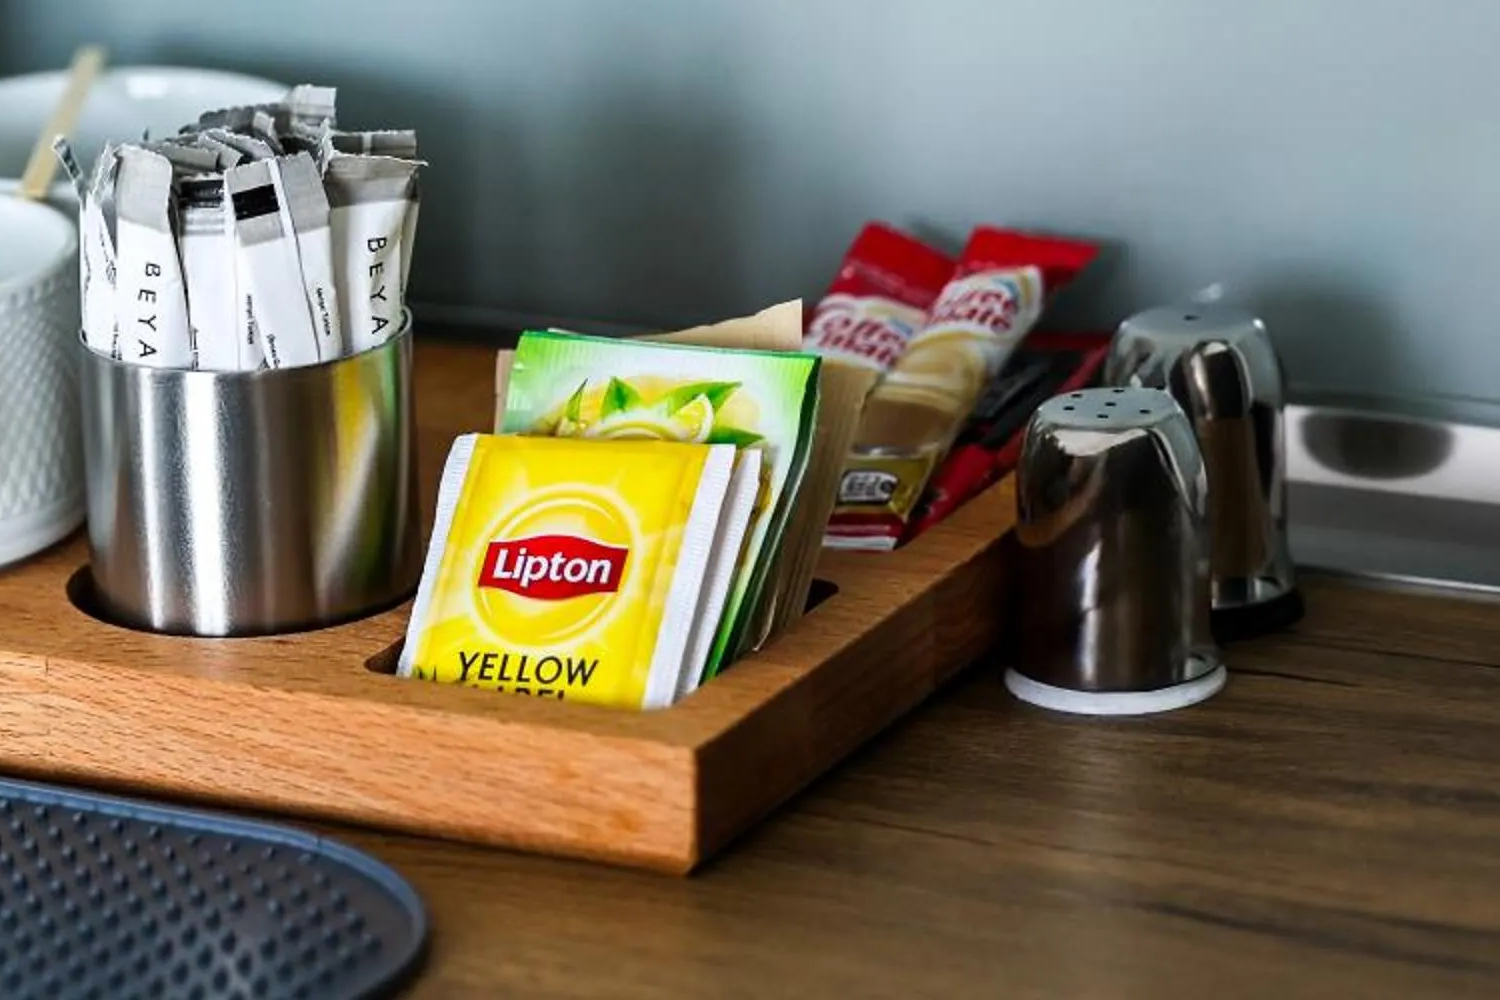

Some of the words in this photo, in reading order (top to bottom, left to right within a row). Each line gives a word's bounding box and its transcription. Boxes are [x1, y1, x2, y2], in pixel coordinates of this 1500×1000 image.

[367, 236, 389, 348] BEYA
[492, 547, 613, 589] Lipton
[458, 651, 600, 688] YELLOW
